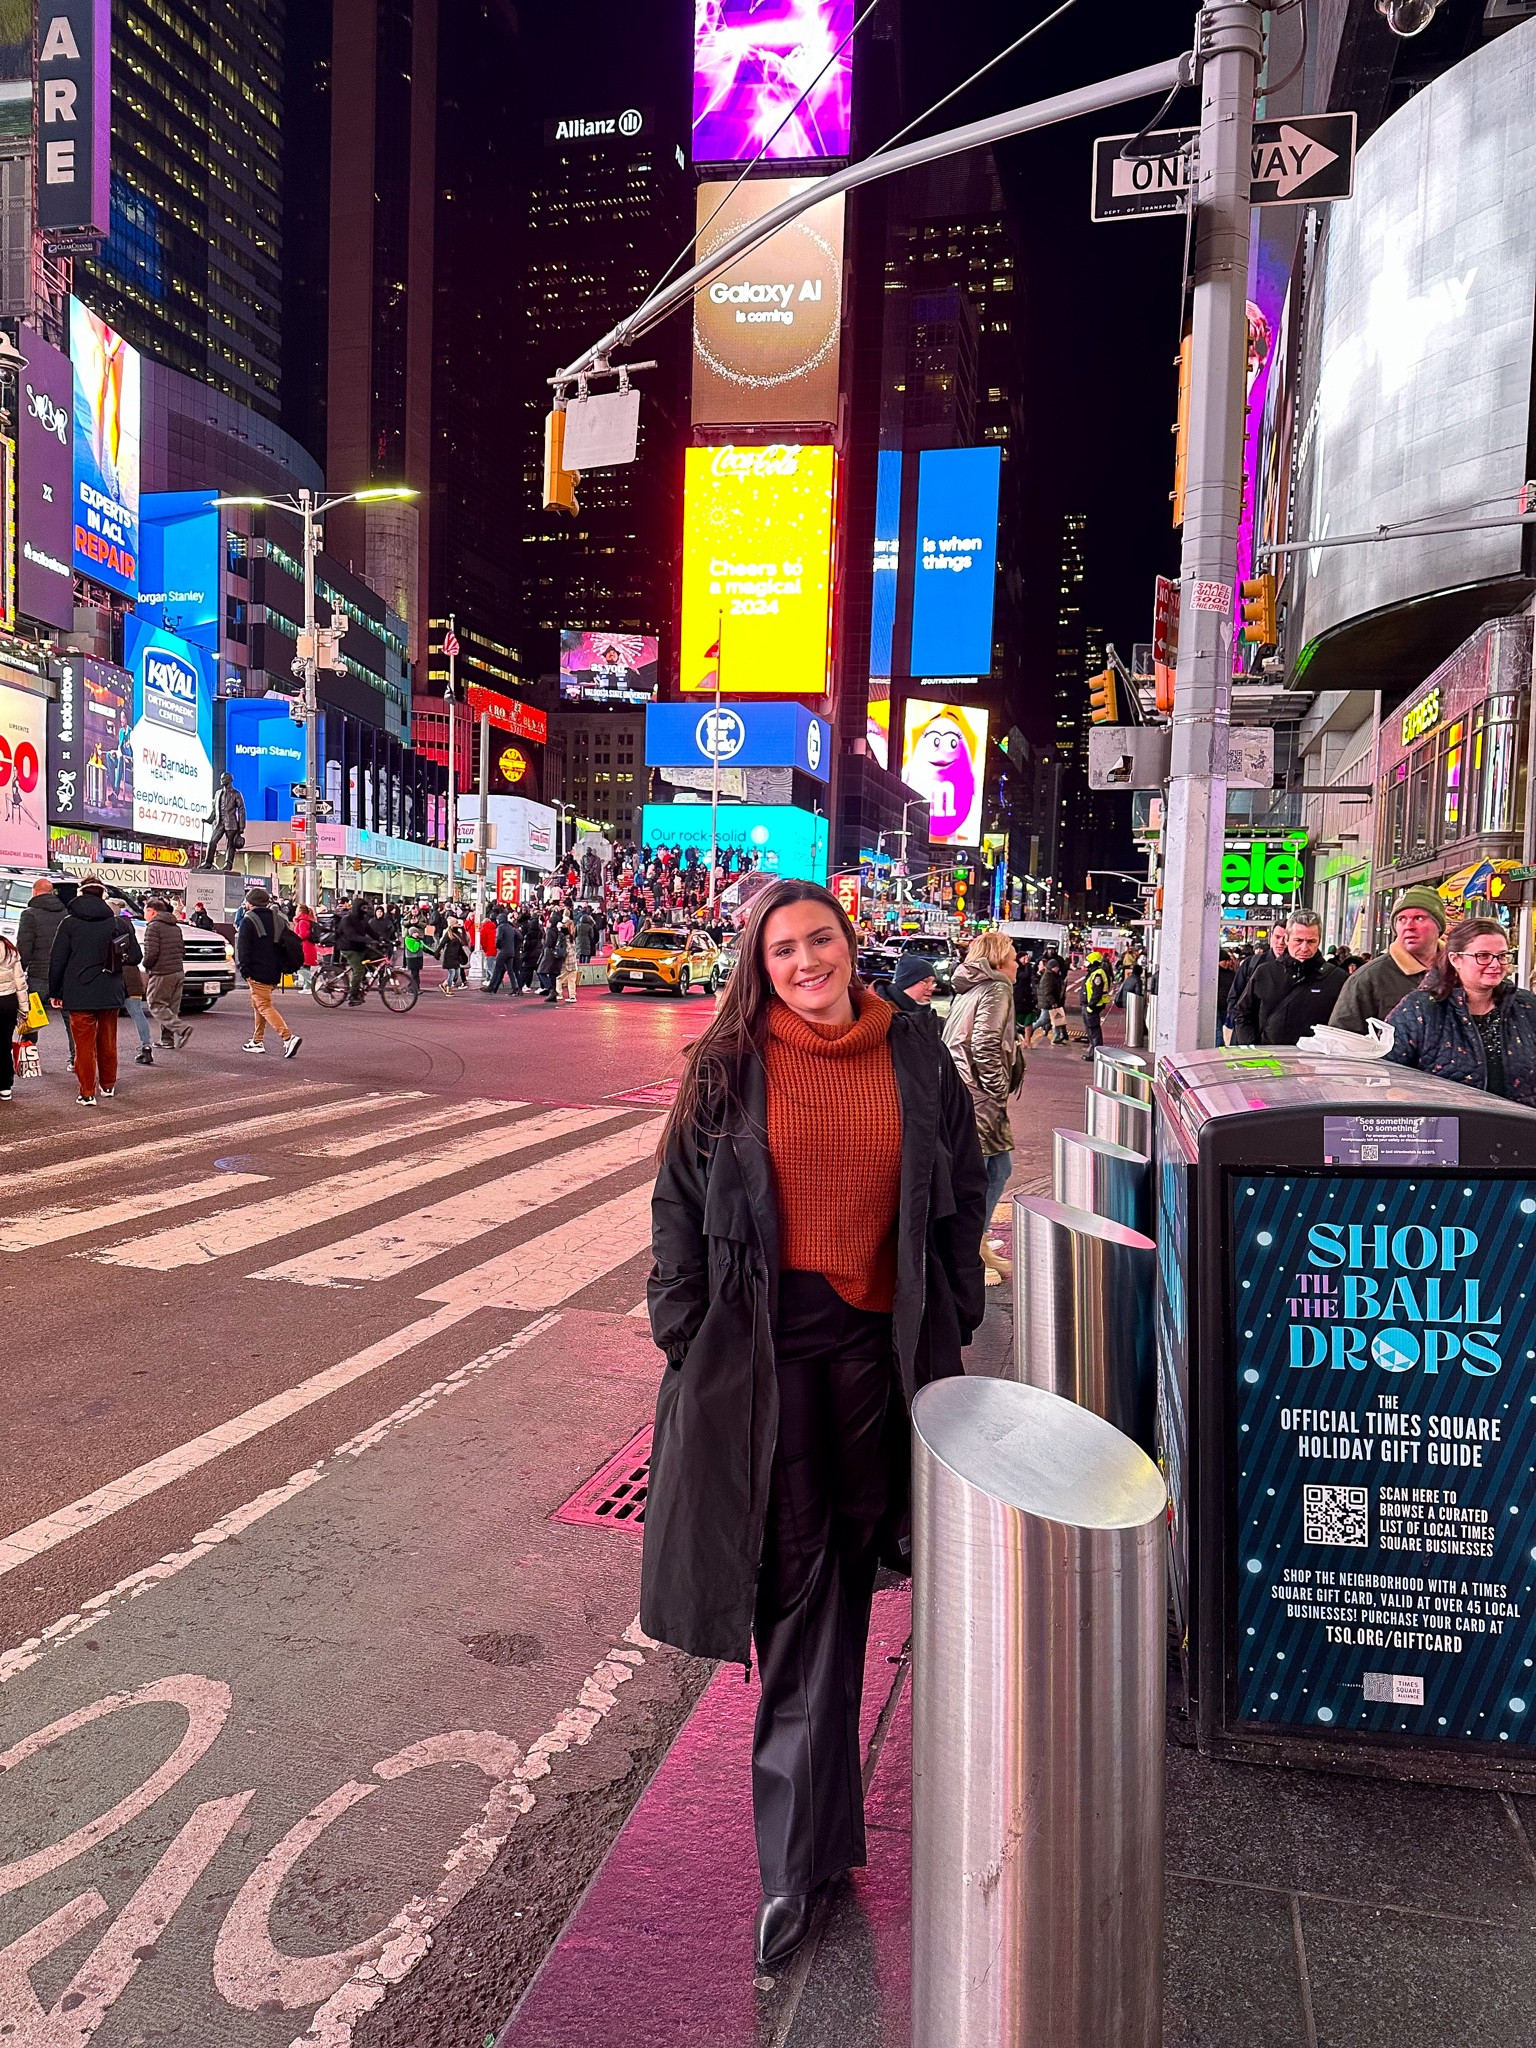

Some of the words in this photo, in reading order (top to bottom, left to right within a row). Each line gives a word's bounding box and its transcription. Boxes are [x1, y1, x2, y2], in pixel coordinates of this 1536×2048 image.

[556, 117, 615, 139] Allianz
[709, 282, 795, 307] Galaxy
[798, 280, 821, 301] AI
[735, 310, 747, 323] is
[748, 310, 794, 325] coming
[80, 482, 132, 528] EXPERTS
[87, 509, 101, 532] IN
[102, 520, 125, 546] ACL
[75, 525, 135, 581] REPAIR
[922, 536, 936, 553] is
[939, 536, 982, 551] when
[709, 558, 778, 577] Cheers
[784, 558, 803, 576] to
[922, 553, 972, 572] things
[709, 580, 722, 594] a
[726, 577, 802, 596] magical
[1160, 588, 1168, 603] NO
[1193, 582, 1230, 594] ISRAEL
[1193, 590, 1230, 600] KILLED
[169, 591, 204, 603] Stanley
[730, 599, 778, 615] 2024
[1191, 603, 1228, 613] CHILDREN
[148, 659, 196, 699] KAYAL
[148, 693, 195, 719] ORTHOPAEDIC
[159, 708, 184, 725] CENTER
[1401, 688, 1440, 747] EXPRESS
[236, 744, 268, 756] Morgan
[269, 746, 301, 760] Stanley
[143, 747, 198, 778] RWJBarnabas
[150, 769, 173, 781] HEALTH
[139, 806, 200, 829] 844.777.0910
[651, 828, 675, 841] Our
[129, 841, 142, 853] FIN
[1511, 866, 1528, 876] LITTLE
[502, 869, 517, 901] tkts
[1376, 1117, 1423, 1125] something?
[1308, 1223, 1478, 1271] SHOP
[1295, 1274, 1338, 1294] TIL
[1286, 1298, 1339, 1318] THE
[1343, 1275, 1501, 1324] BALL
[1289, 1324, 1502, 1377] DROPS
[1378, 1395, 1398, 1409] THE
[1281, 1408, 1359, 1433] OFFICIAL
[1366, 1412, 1421, 1436] TIMES
[1428, 1415, 1500, 1441] SQUARE
[1299, 1436, 1374, 1461] HOLIDAY
[1381, 1440, 1421, 1463] GIFT
[1428, 1442, 1482, 1468] GUIDE
[1380, 1487, 1408, 1501] SCAN
[1413, 1488, 1439, 1503] HERE
[1443, 1491, 1457, 1504] TO
[1380, 1503, 1424, 1519] BROWSE
[1428, 1506, 1435, 1519] A
[1439, 1507, 1488, 1523] CURATED
[1380, 1519, 1403, 1533] LIST
[1407, 1521, 1420, 1535] OF
[1424, 1522, 1457, 1538] LOCAL
[1461, 1525, 1495, 1540] TIMES
[1380, 1536, 1422, 1551] SQUARE
[1426, 1539, 1493, 1557] BUSINESSES
[1284, 1569, 1312, 1583] SHOP
[1315, 1571, 1335, 1585] THE
[1340, 1572, 1424, 1592] NEIGHBORHOOD
[1428, 1579, 1456, 1594] WITH
[1461, 1582, 1468, 1595] A
[1472, 1582, 1507, 1598] TIMES
[1272, 1586, 1313, 1601] SQUARE
[1317, 1589, 1340, 1603] GIFT
[1345, 1591, 1377, 1607] CARD,
[1381, 1593, 1413, 1608] VALID
[1417, 1596, 1430, 1609] AT
[1435, 1597, 1463, 1612] OVER
[1467, 1600, 1480, 1614] 45
[1485, 1601, 1520, 1618] LOCAL
[1287, 1604, 1357, 1621] BUSINESSES!
[1362, 1609, 1418, 1627] PURCHASE
[1423, 1614, 1451, 1630] YOUR
[1456, 1617, 1485, 1633] CARD
[1490, 1621, 1504, 1634] AT
[1326, 1626, 1462, 1653] TSQ.ORG/GIFTCARD
